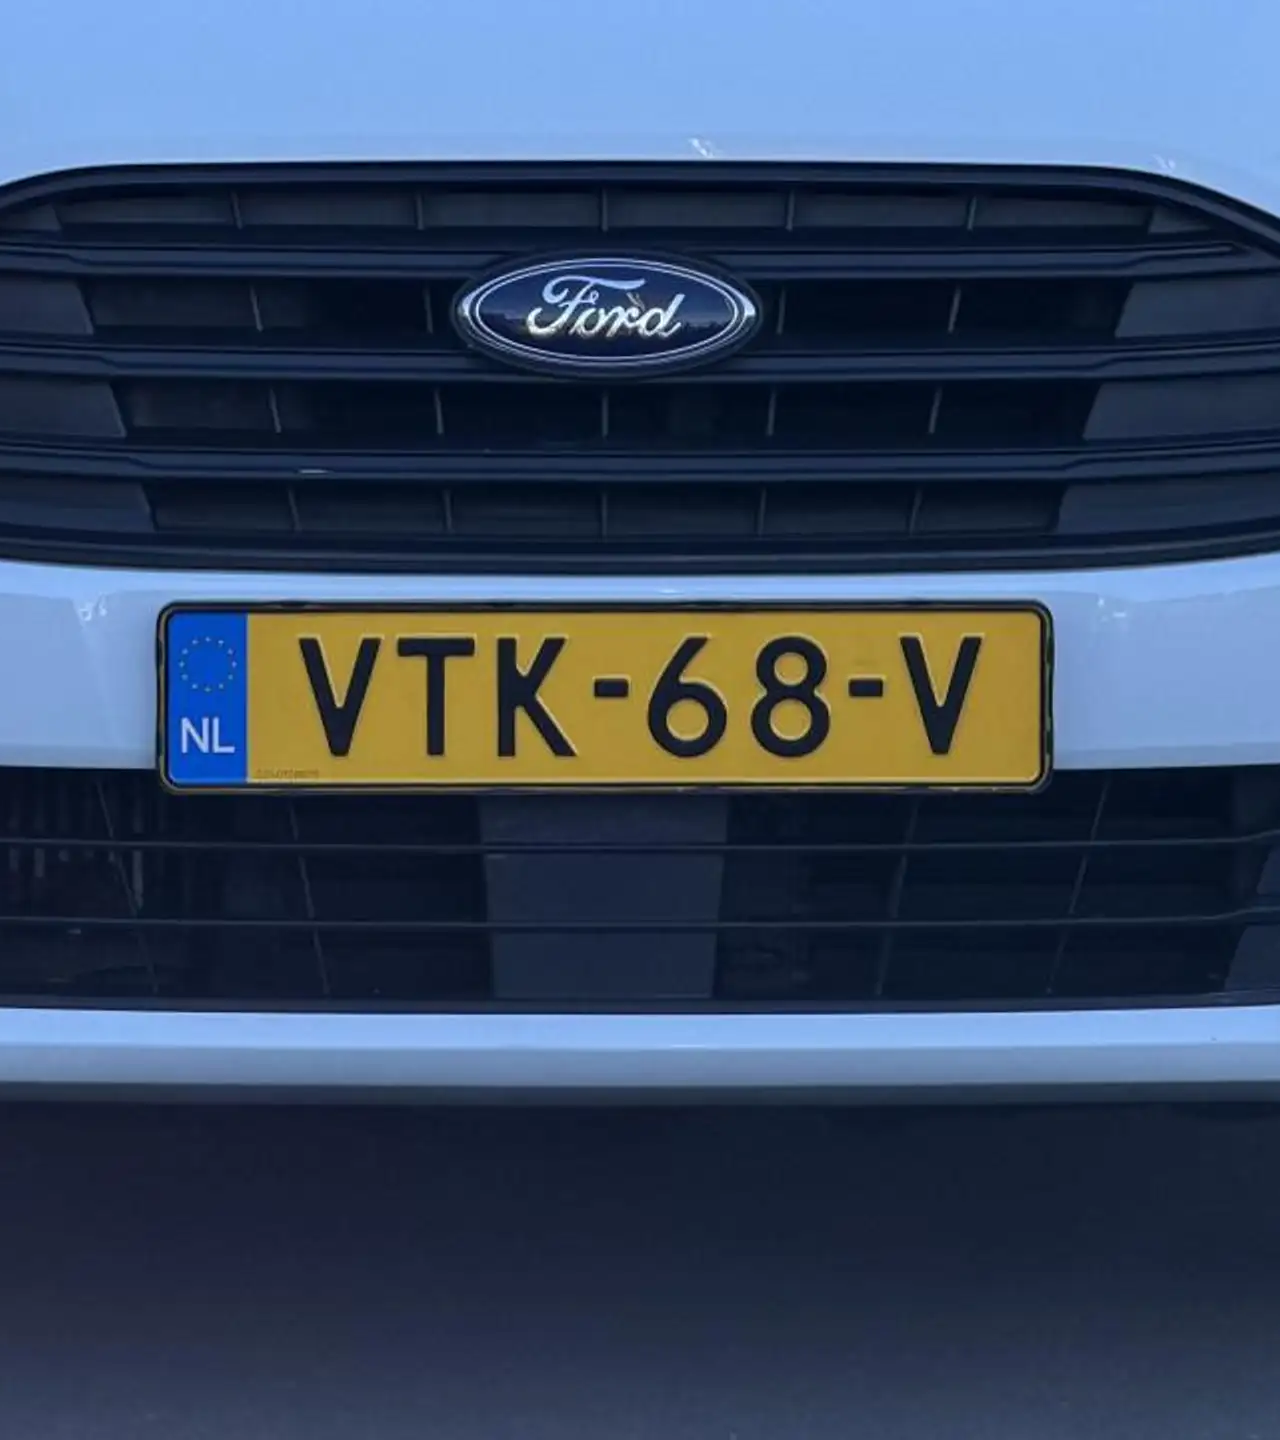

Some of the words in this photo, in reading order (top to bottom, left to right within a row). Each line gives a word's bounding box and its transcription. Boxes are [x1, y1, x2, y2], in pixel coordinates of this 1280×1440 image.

[524, 274, 686, 339] Ford
[298, 636, 982, 758] VTK-68-V
[179, 719, 235, 754] NL
